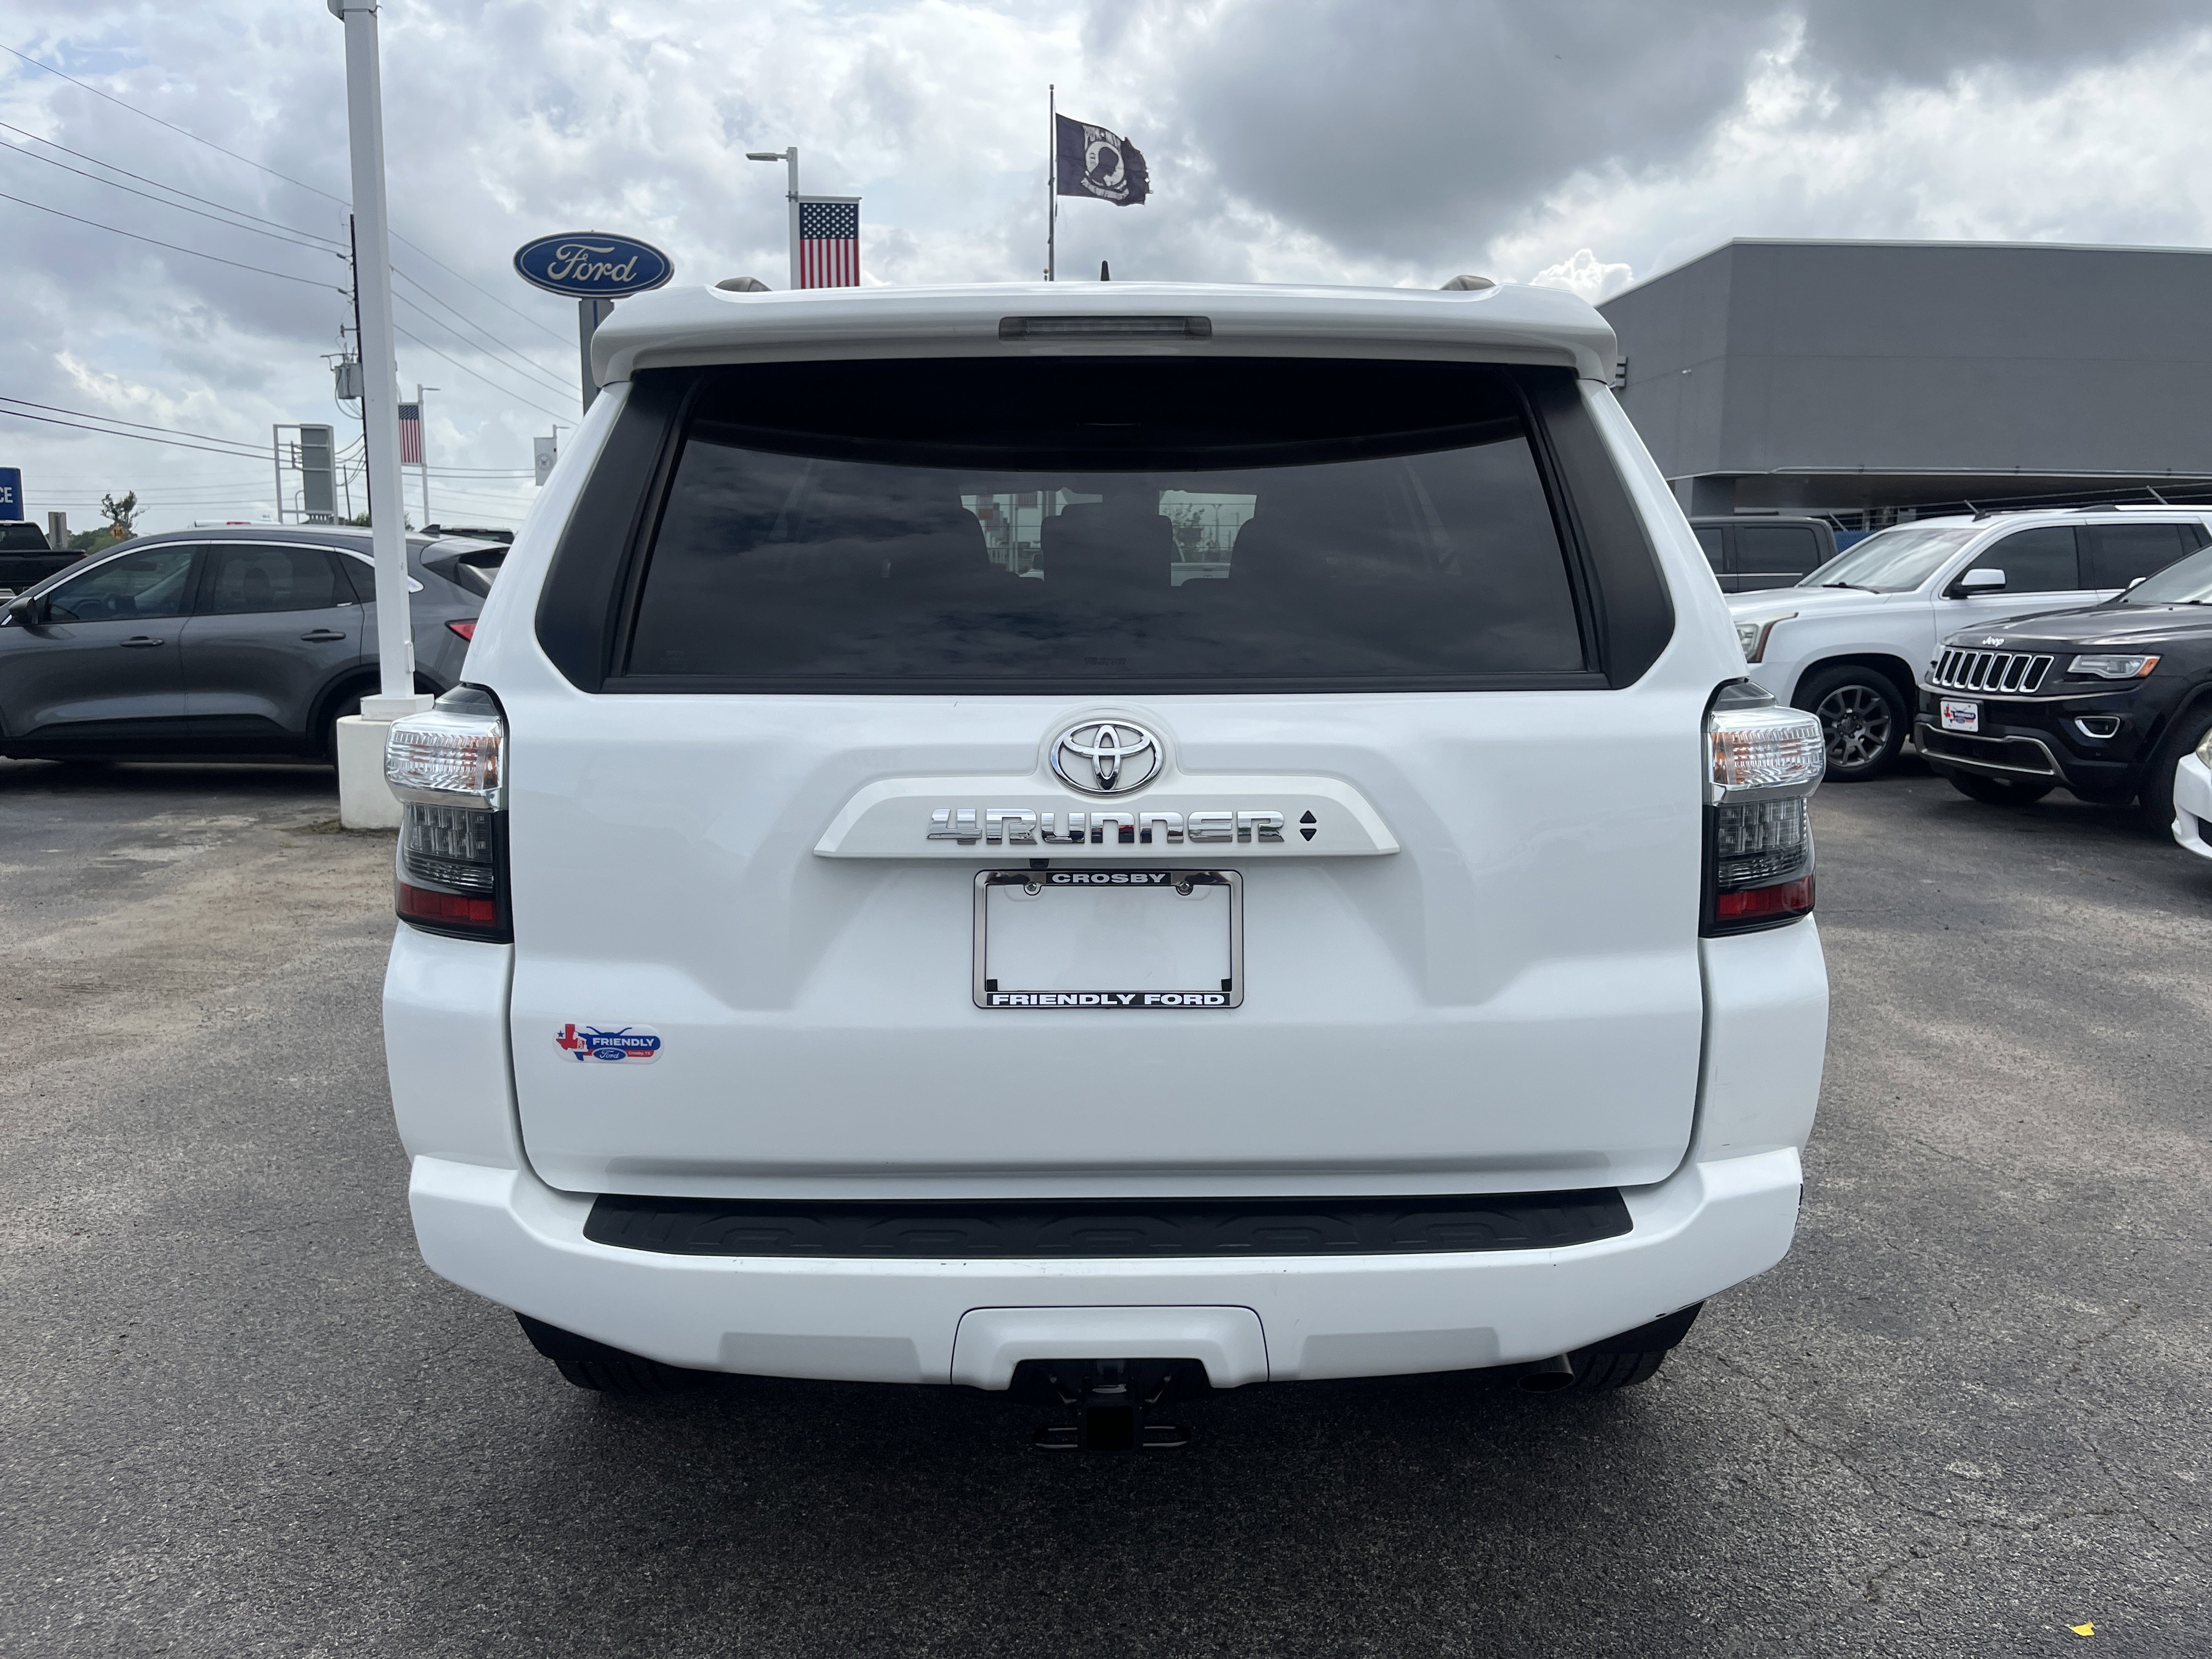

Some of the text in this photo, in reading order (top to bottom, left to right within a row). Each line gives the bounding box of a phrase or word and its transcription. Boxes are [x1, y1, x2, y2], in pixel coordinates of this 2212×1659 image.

[547, 244, 639, 281] Ford
[1982, 636, 2005, 647] Jeep
[1051, 873, 1166, 884] CROSBY
[992, 994, 1225, 1006] FRIENDLY FORD
[592, 1037, 654, 1047] FRIENDLY
[599, 1049, 620, 1059] Ford
